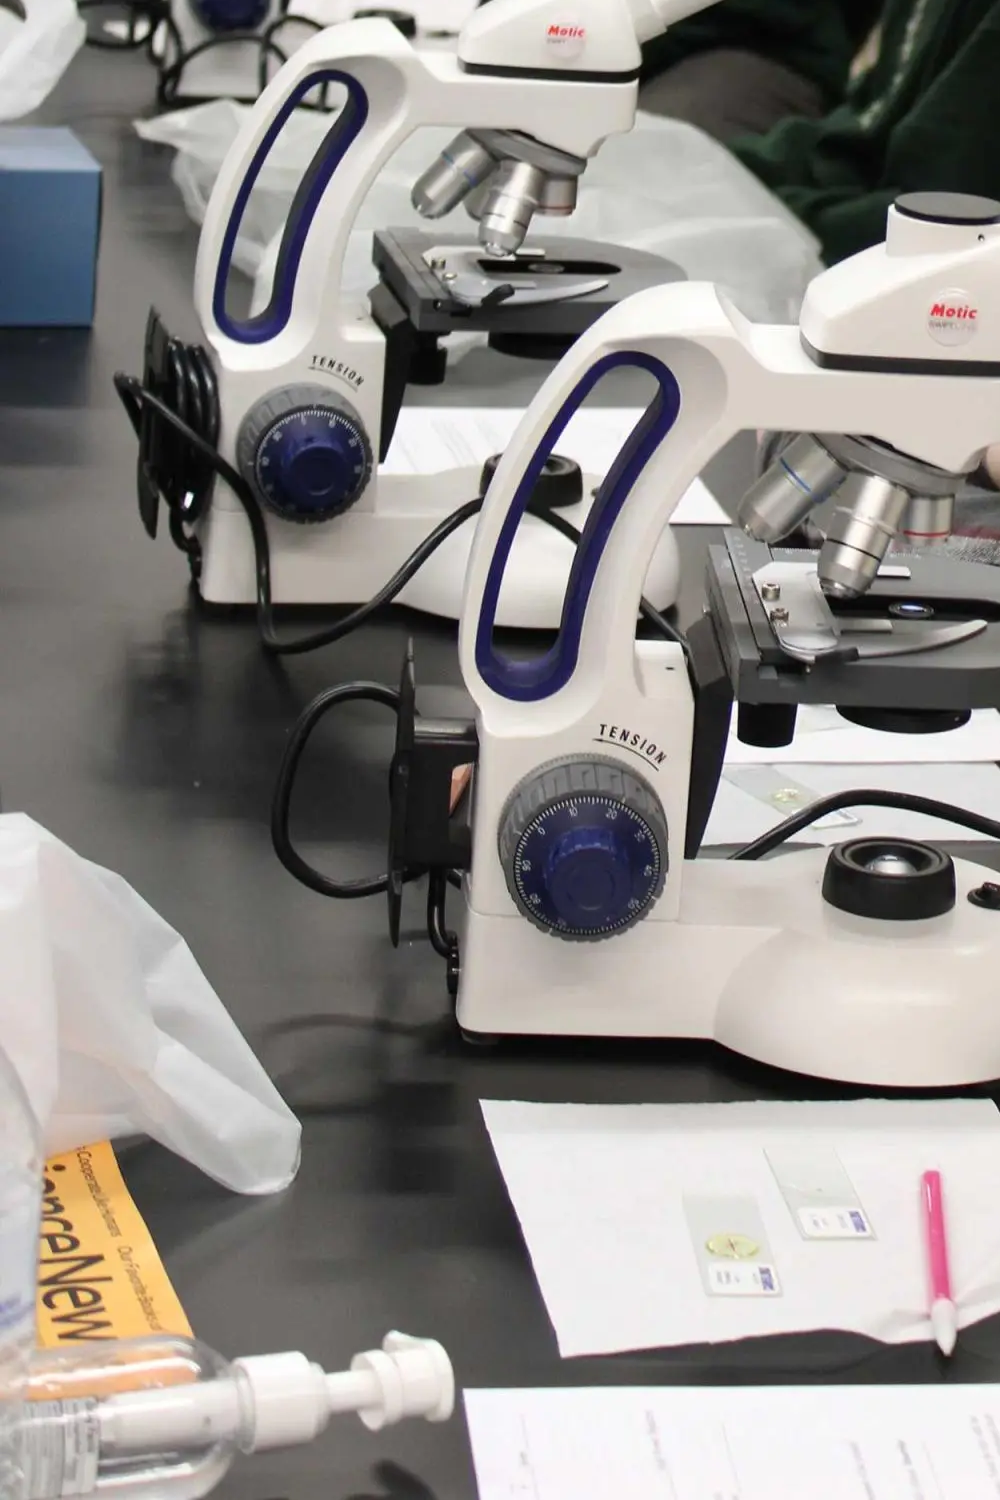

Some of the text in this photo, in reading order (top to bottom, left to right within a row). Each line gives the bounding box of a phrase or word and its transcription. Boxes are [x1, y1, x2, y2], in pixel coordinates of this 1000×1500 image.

[547, 25, 585, 38] Motic
[930, 303, 978, 320] Motic
[312, 355, 365, 387] TENSION
[599, 724, 667, 764] TENSION
[569, 808, 578, 818] 10
[605, 808, 617, 820] 20
